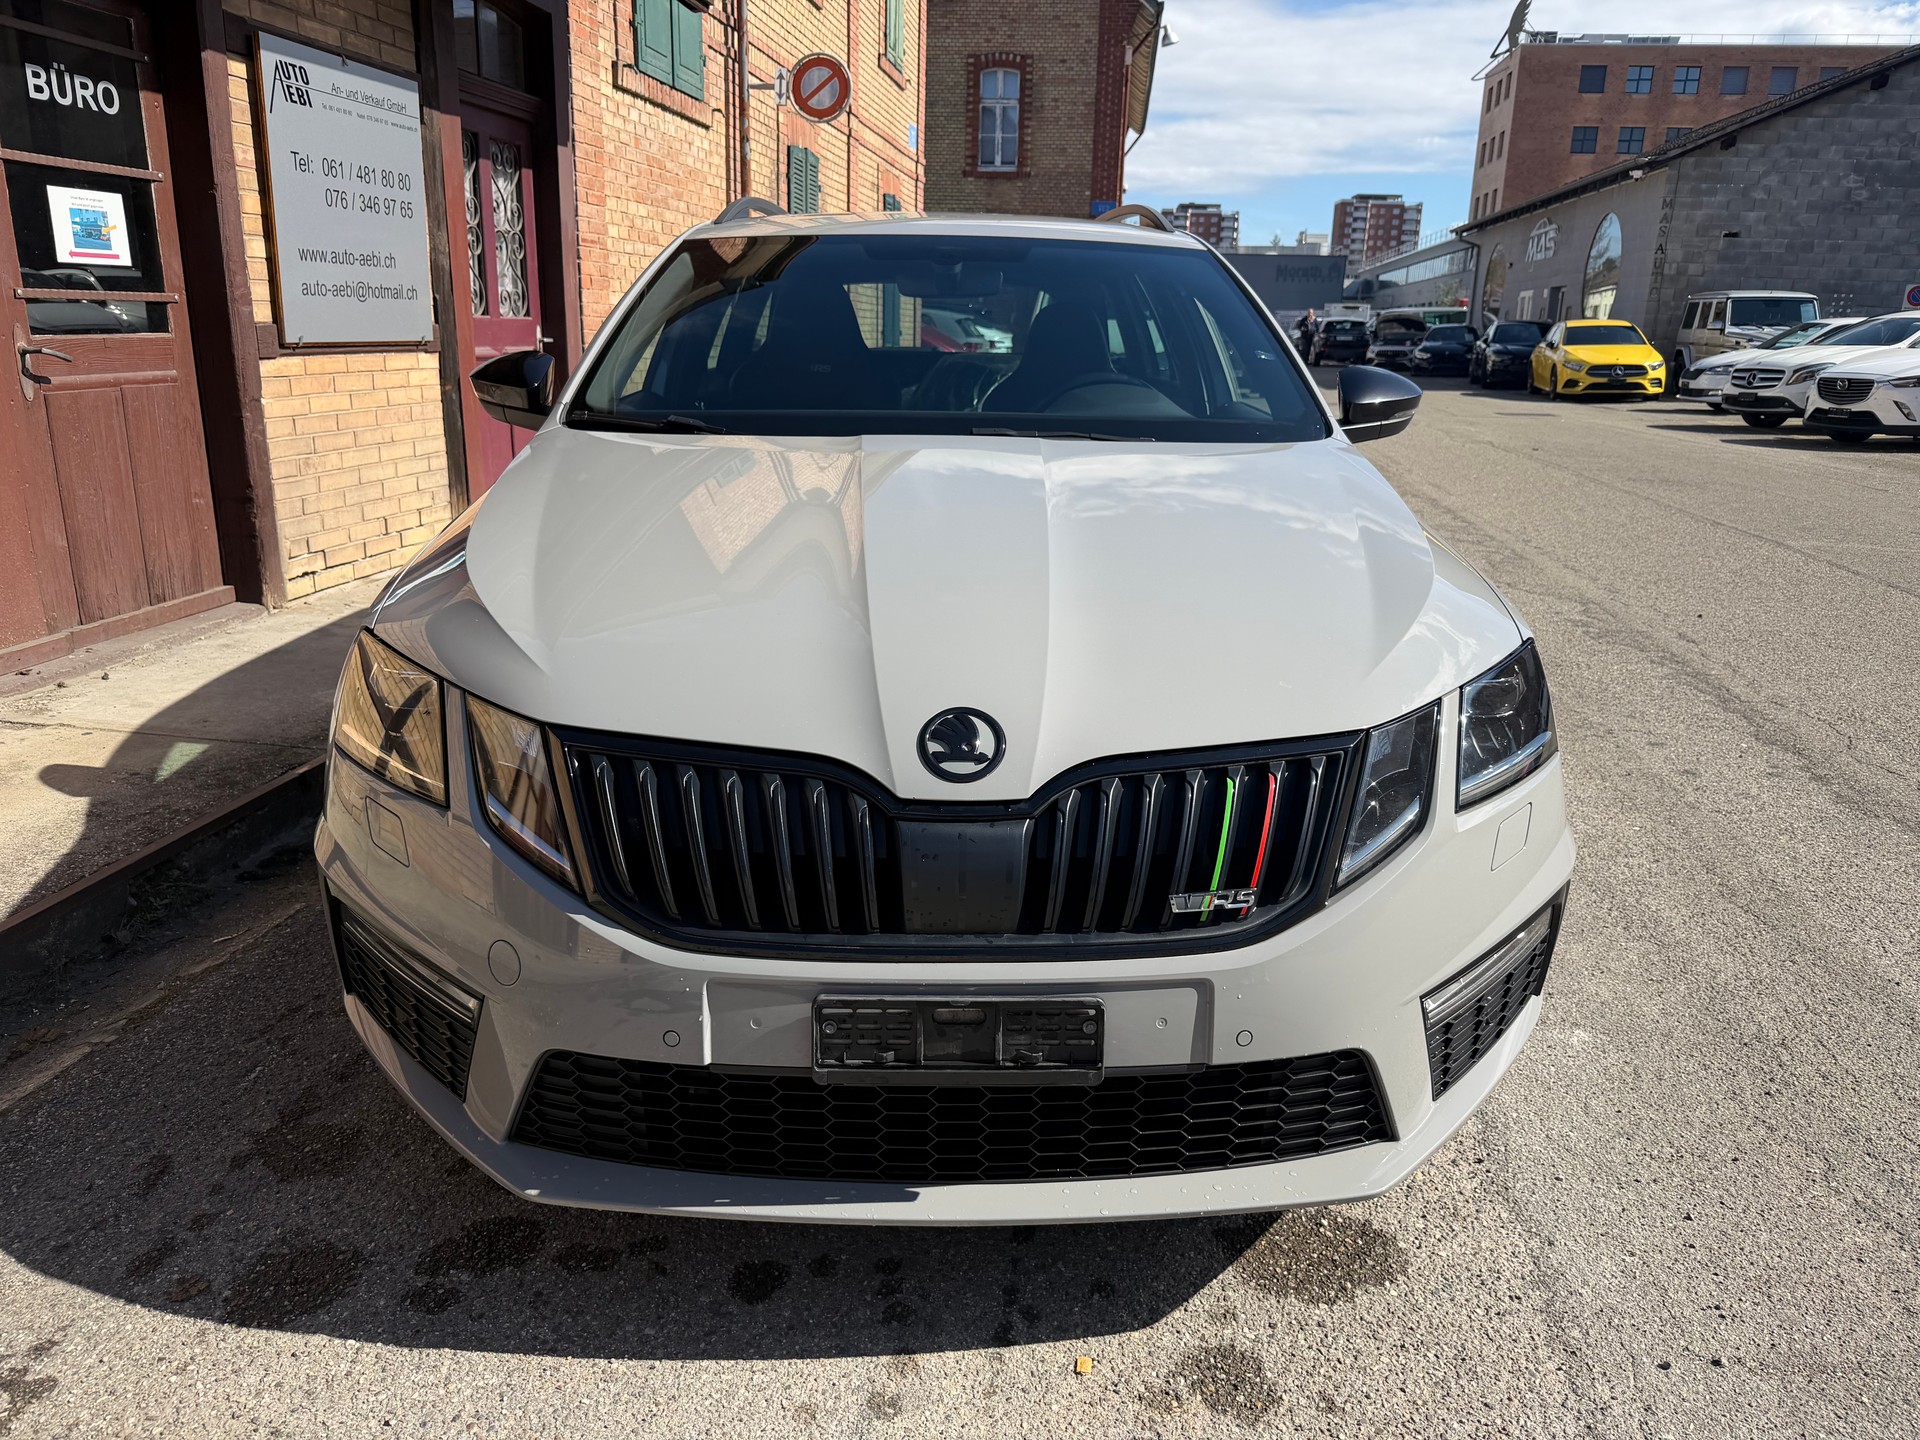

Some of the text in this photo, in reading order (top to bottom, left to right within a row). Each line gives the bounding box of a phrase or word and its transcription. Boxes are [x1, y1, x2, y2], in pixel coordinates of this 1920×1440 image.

[25, 62, 120, 115] BÜRO
[331, 82, 407, 113] An- und Verkauf GmbH
[290, 150, 411, 192] Tel: 061 / 481 80 80
[325, 187, 413, 219] 076 / 346 97 65
[297, 247, 397, 269] www.auto-aebi.ch
[1525, 222, 1559, 263] MAS
[301, 280, 418, 303] auto-aebi@hotmail.ch
